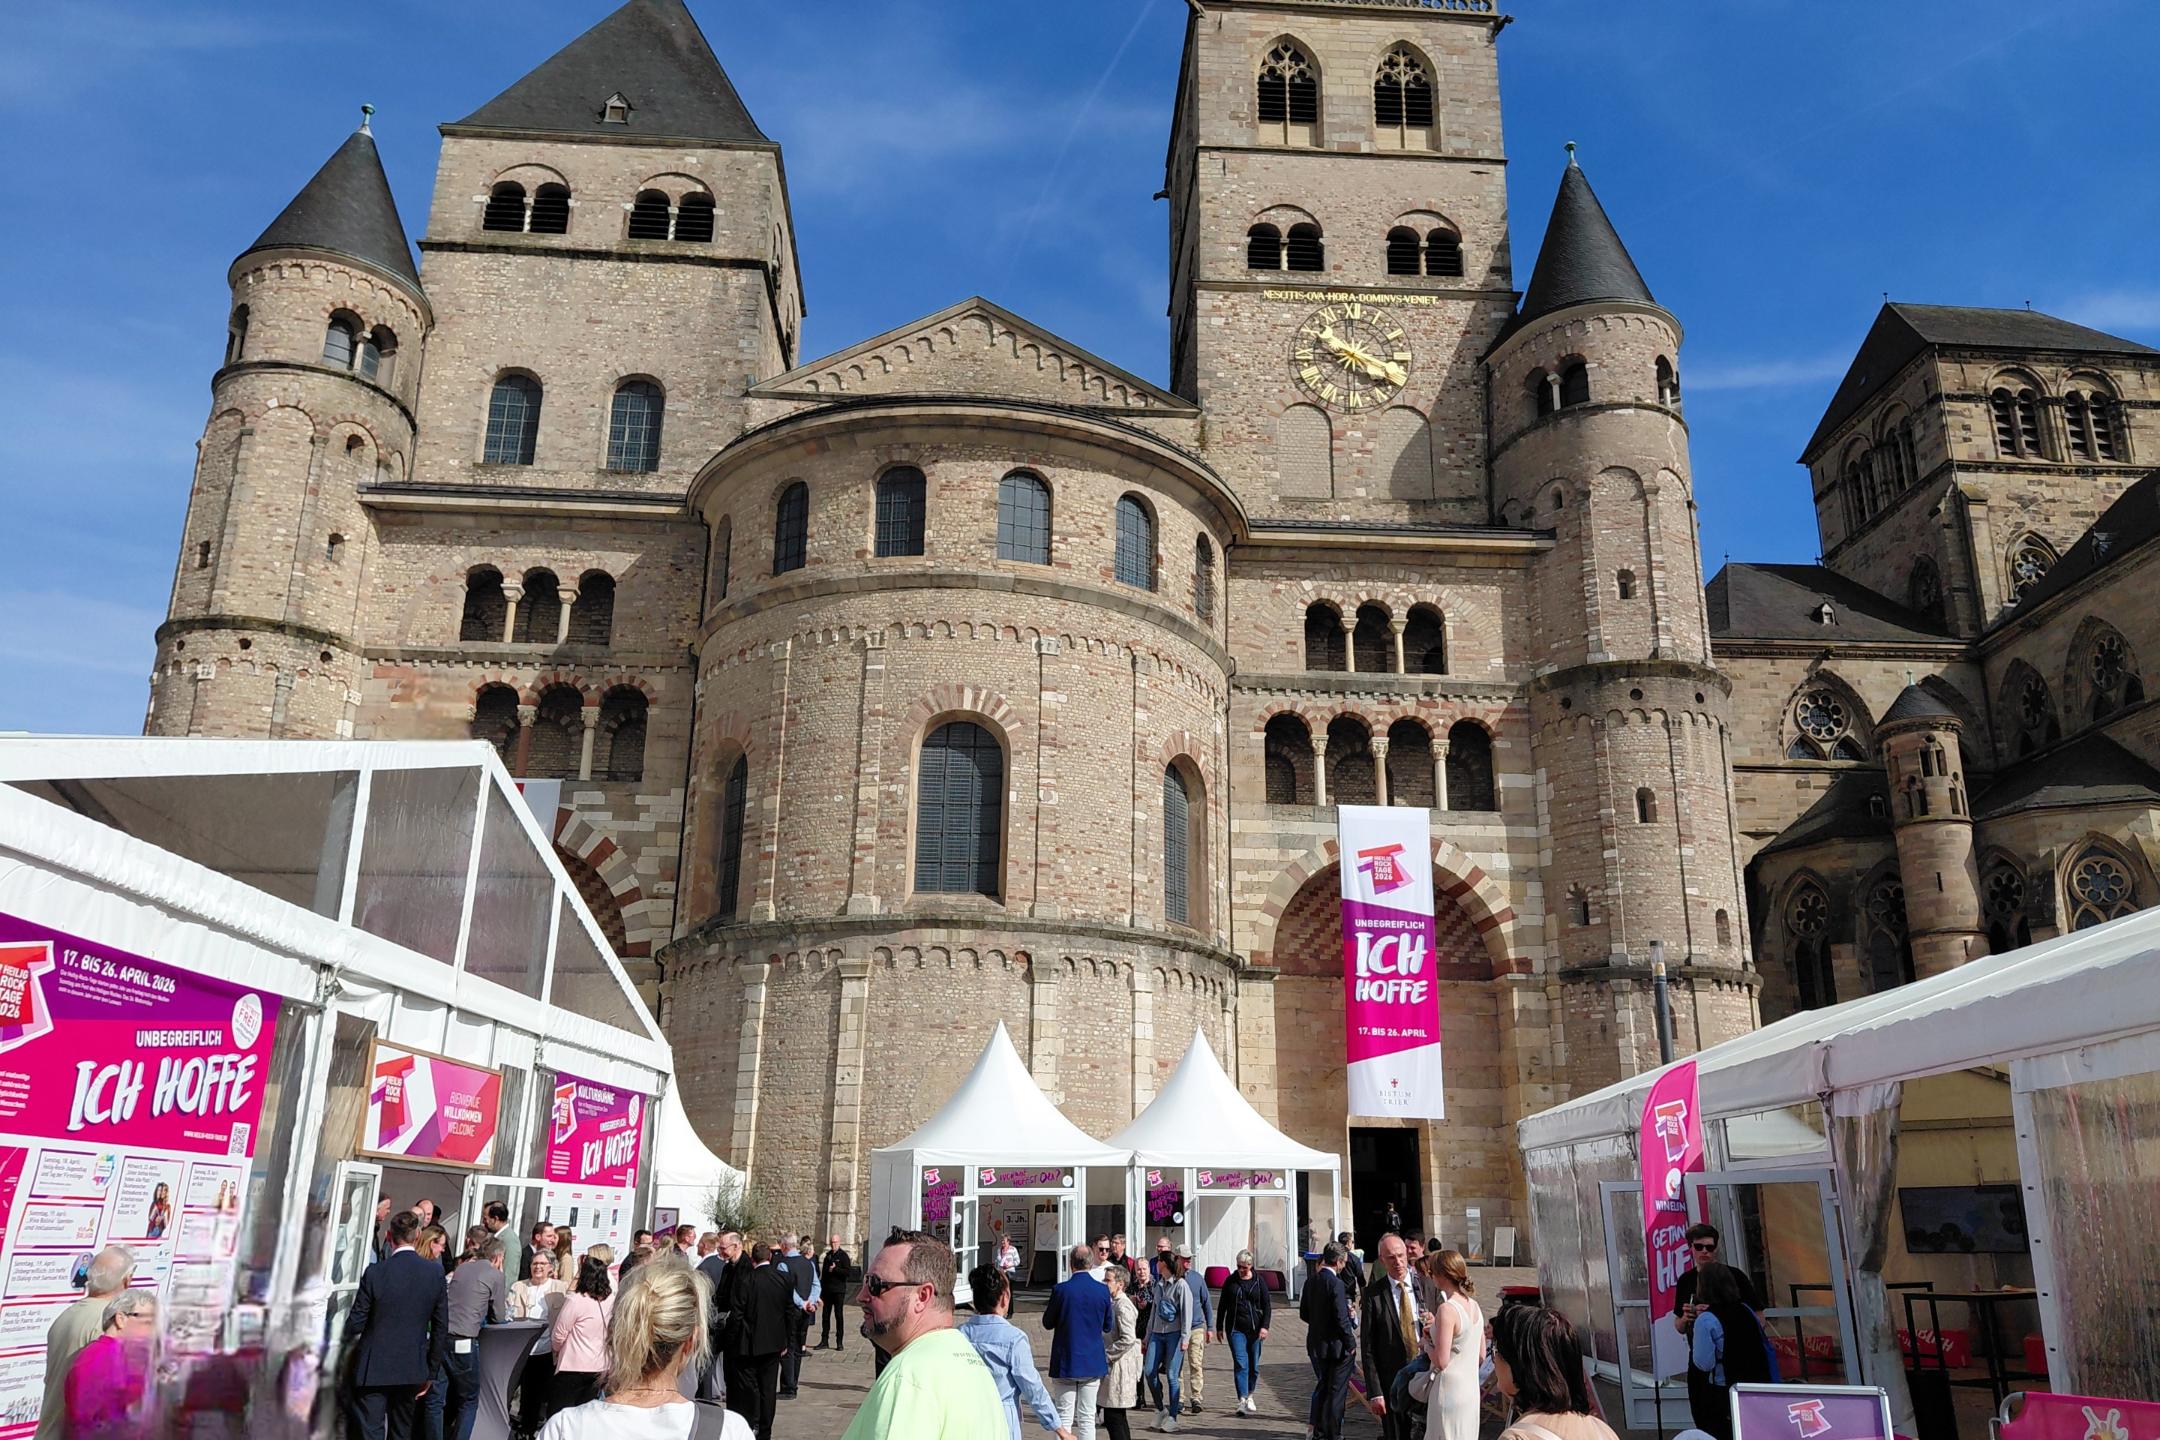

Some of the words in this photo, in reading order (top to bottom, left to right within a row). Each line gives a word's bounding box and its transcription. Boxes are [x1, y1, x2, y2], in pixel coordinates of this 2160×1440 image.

[1327, 292, 1356, 301] HORA
[1359, 293, 1402, 303] DOMINVS
[1355, 918, 1425, 930] UNBEGREIFLICH
[1355, 931, 1428, 977] ICH
[2, 964, 29, 980] HEILIG
[63, 949, 79, 968] 17.
[81, 954, 102, 973] BIS
[101, 961, 118, 979] 26.
[119, 966, 152, 988] APRIL
[152, 974, 176, 994] 2026
[0, 975, 27, 991] ROCK
[1355, 978, 1429, 1005] HOFFE
[0, 988, 24, 1005] TAGE
[0, 1002, 20, 1019] 026
[136, 1029, 222, 1048] UNBEGREIFLICH
[1357, 1026, 1370, 1036] 17.
[1372, 1027, 1386, 1036] BIS
[1387, 1028, 1400, 1037] 26.
[1402, 1028, 1428, 1038] APRIL
[66, 1059, 145, 1132] ICH
[152, 1054, 258, 1118] HOFFE
[386, 1085, 401, 1097] ROCK
[443, 1105, 483, 1123] WILLKOMMEN
[447, 1122, 476, 1137] WELCOME
[580, 1138, 603, 1180] ICH
[604, 1129, 638, 1169] HOFFE
